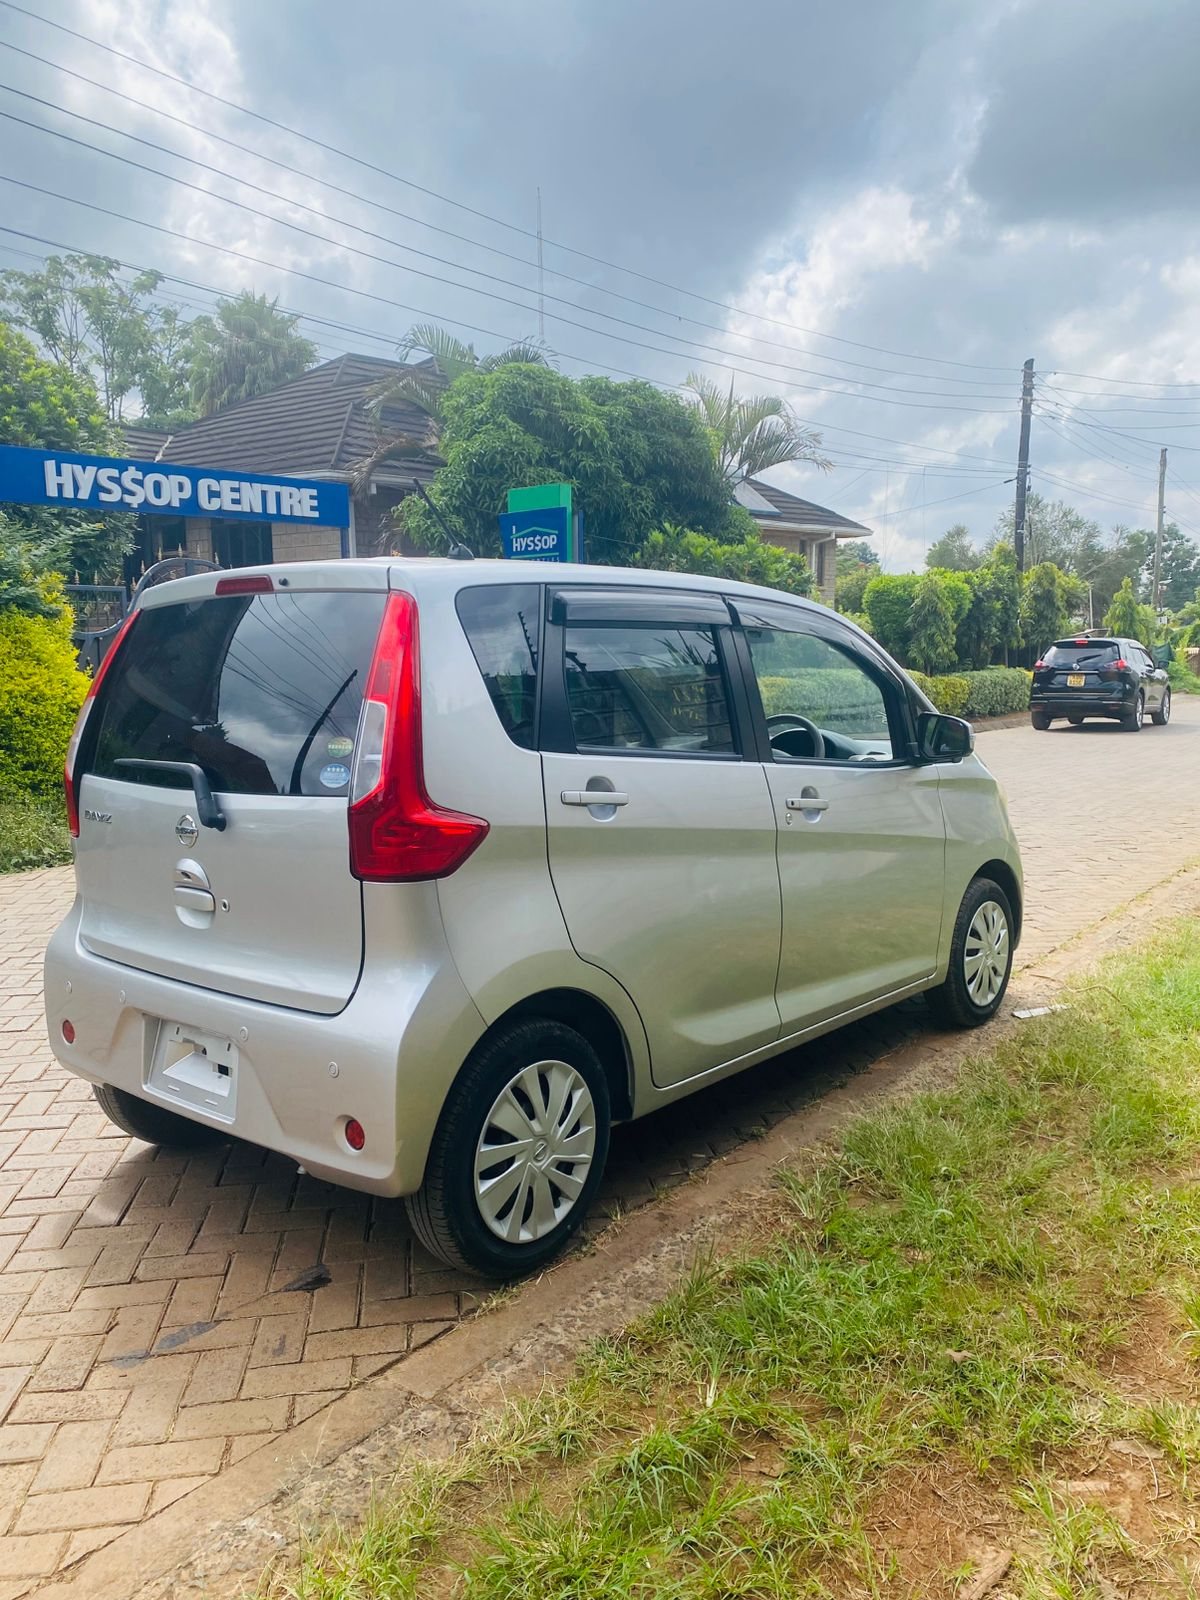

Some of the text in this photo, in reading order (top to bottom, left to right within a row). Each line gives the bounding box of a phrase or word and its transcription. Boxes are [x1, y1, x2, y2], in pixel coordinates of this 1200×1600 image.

[44, 459, 320, 518] HYS$OP CENTRE
[512, 534, 557, 552] HYS$OP
